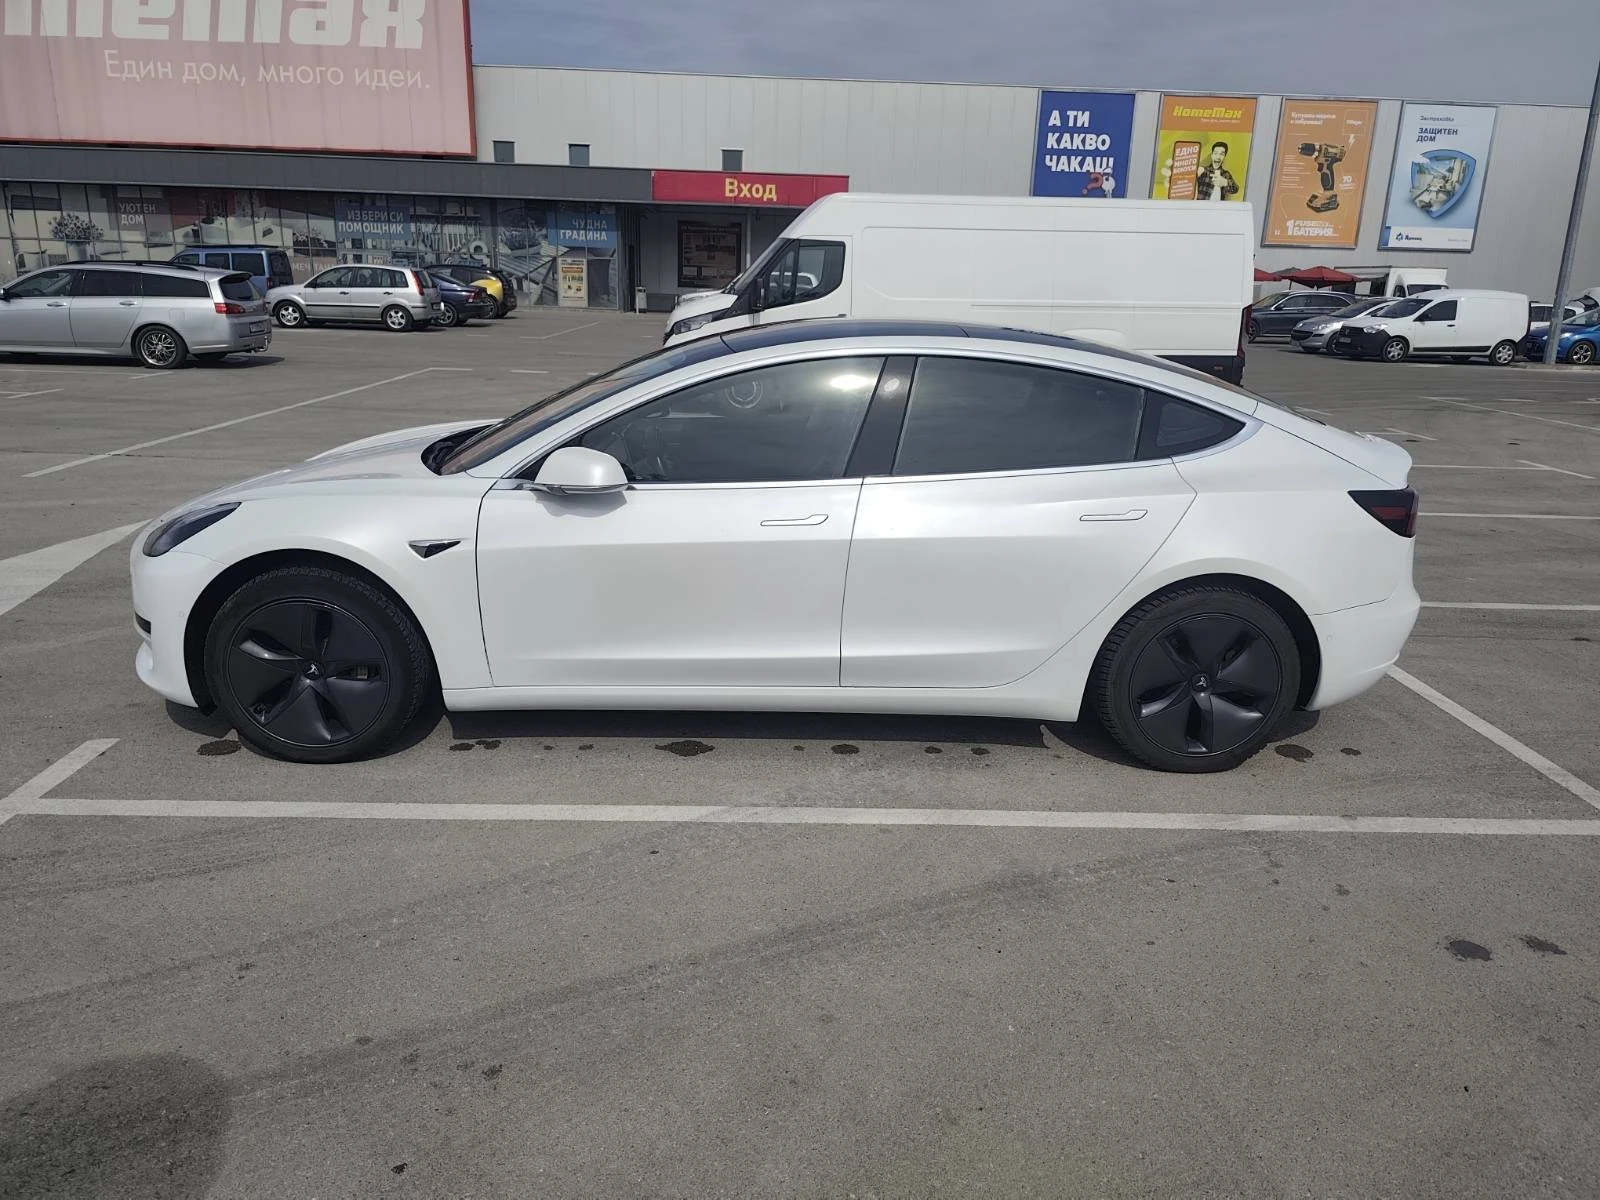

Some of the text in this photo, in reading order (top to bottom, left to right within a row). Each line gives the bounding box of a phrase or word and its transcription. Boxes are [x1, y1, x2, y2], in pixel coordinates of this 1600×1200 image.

[104, 49, 431, 91] Един дом, много идеи.
[1048, 109, 1090, 128] А ТИ
[1418, 127, 1459, 136] ЗАЩИТЕН
[1046, 132, 1111, 151] КАКВО
[1416, 135, 1437, 143] ДОМ
[724, 177, 777, 202] Вход
[119, 203, 156, 213] УЮТЕН
[121, 214, 144, 226] ДОМ
[347, 209, 404, 222] ИЗБЕРИ СИ
[338, 221, 404, 235] ПОМОЩНИК
[572, 218, 608, 231] ЧУДНА
[560, 229, 608, 242] ГРАДИНА
